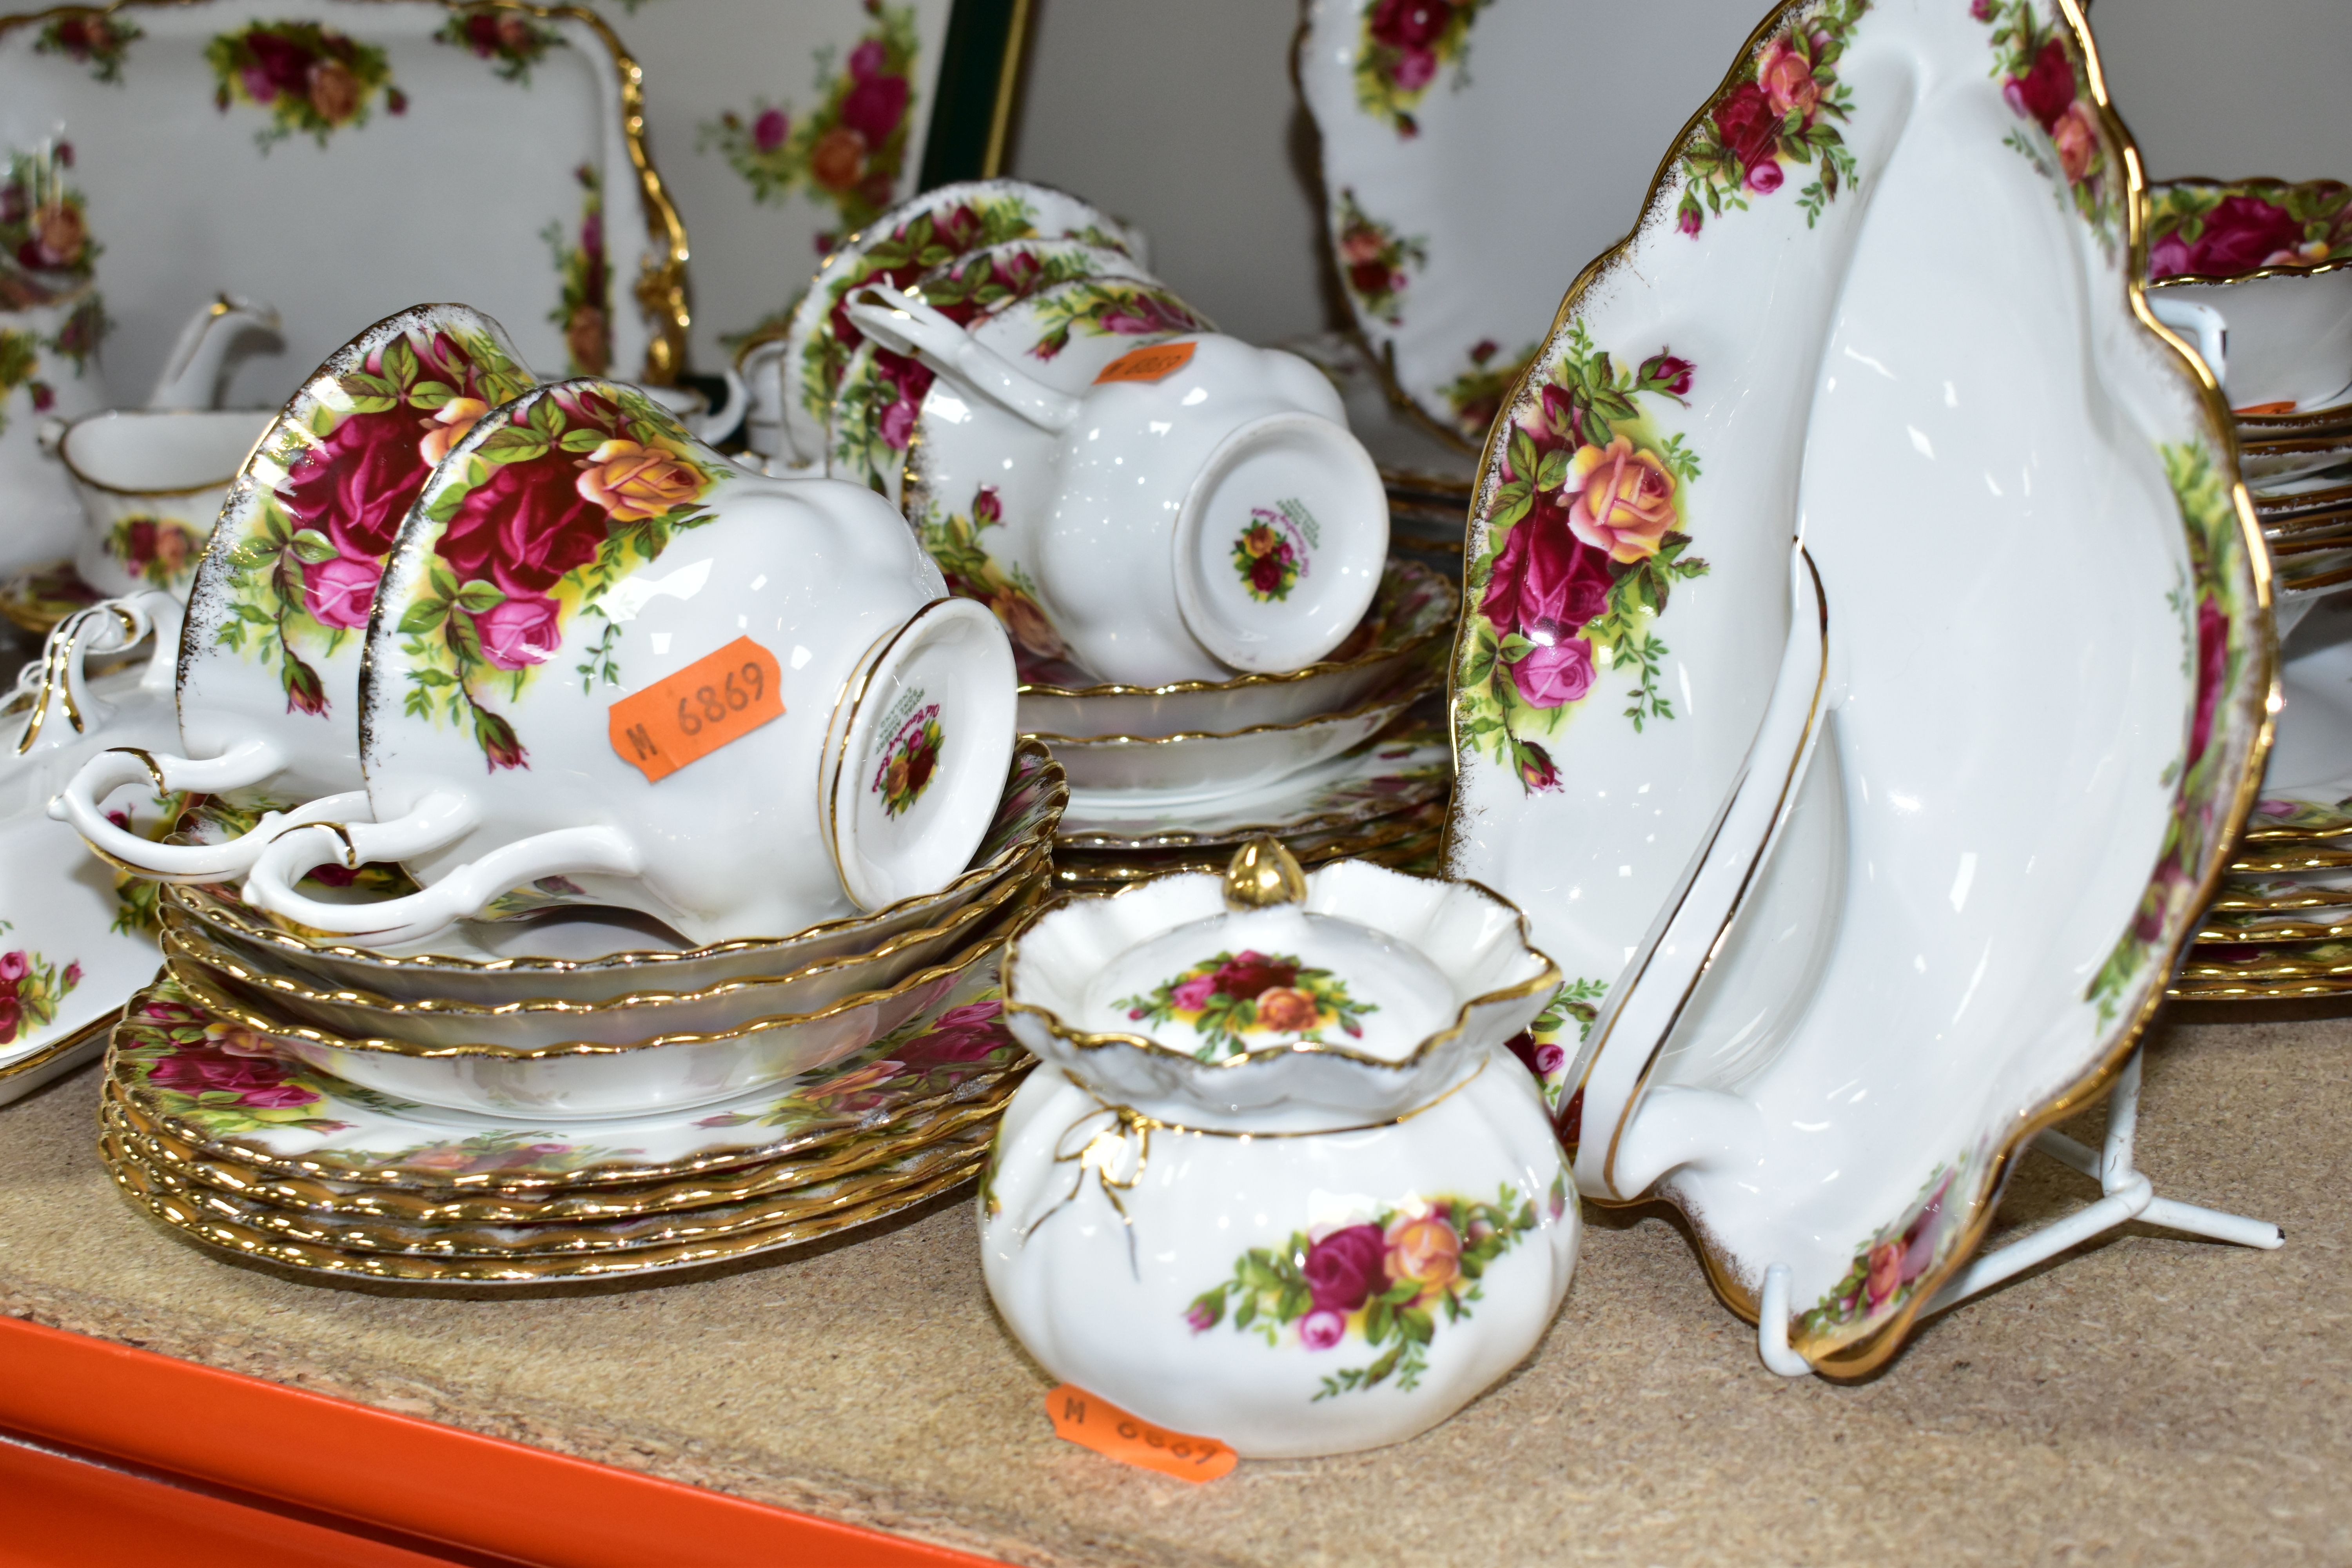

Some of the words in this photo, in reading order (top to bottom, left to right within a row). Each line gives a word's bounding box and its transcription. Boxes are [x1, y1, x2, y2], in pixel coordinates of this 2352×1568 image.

[625, 723, 658, 760] M
[678, 662, 764, 736] 6869
[880, 686, 913, 728] ENGLAND
[899, 688, 918, 714] BONE
[903, 688, 925, 717] ROYAL
[877, 718, 901, 755] ALBERT
[879, 713, 899, 739] CHINA
[890, 709, 925, 751] Country
[872, 751, 892, 792] Roses
[1064, 1397, 1085, 1424] M
